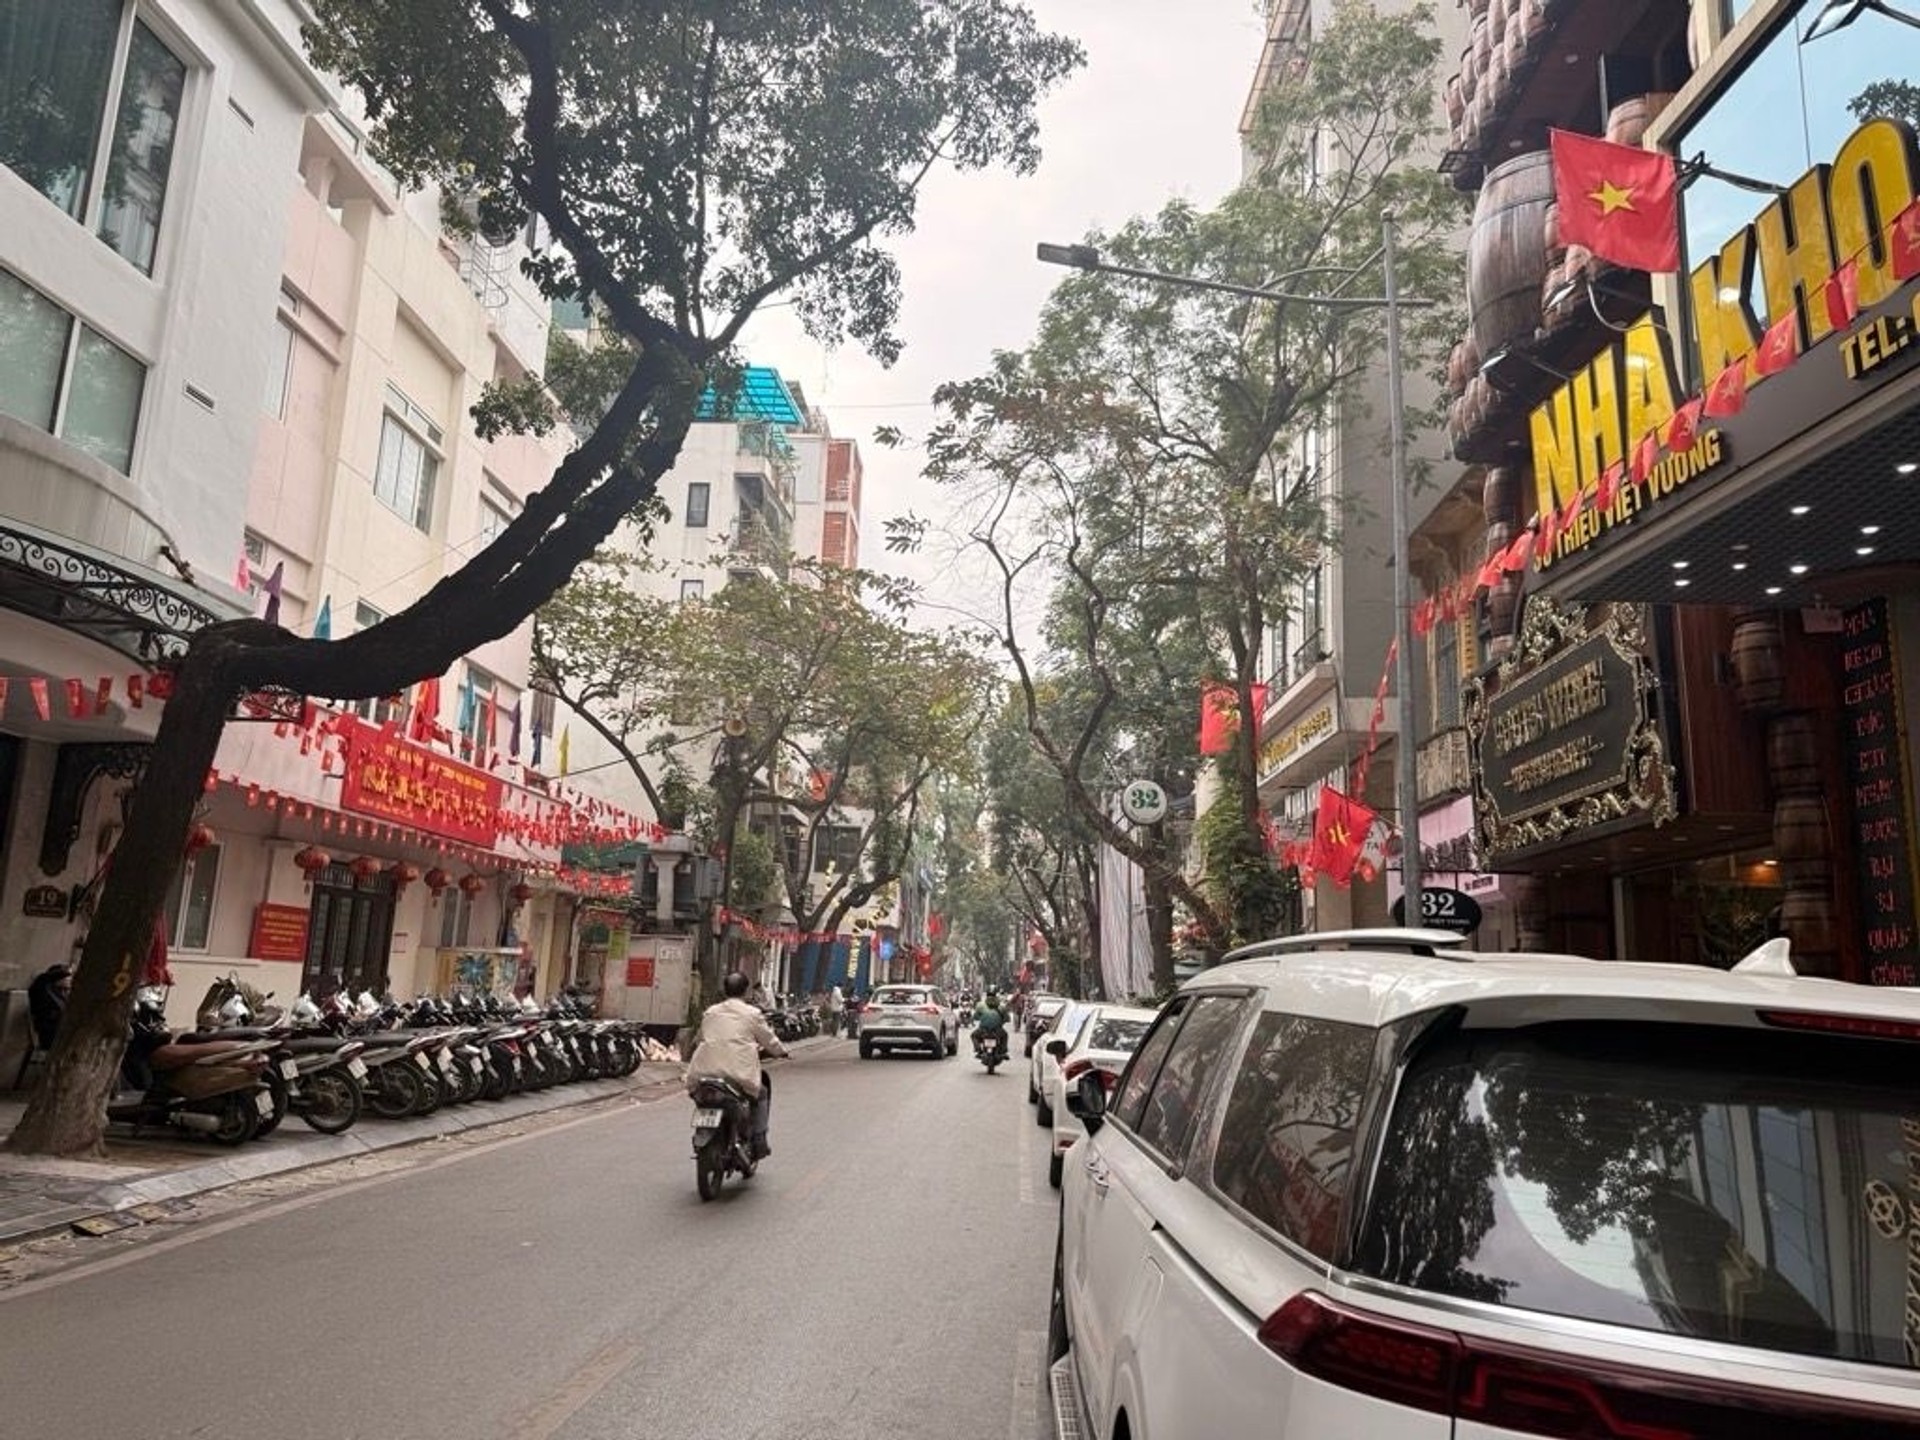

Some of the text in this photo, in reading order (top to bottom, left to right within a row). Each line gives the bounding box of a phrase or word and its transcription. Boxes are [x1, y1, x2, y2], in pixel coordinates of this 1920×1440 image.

[1690, 119, 1912, 392] KHO
[1839, 316, 1909, 379] TEL:
[1132, 789, 1160, 809] 32
[1421, 892, 1456, 916] 32
